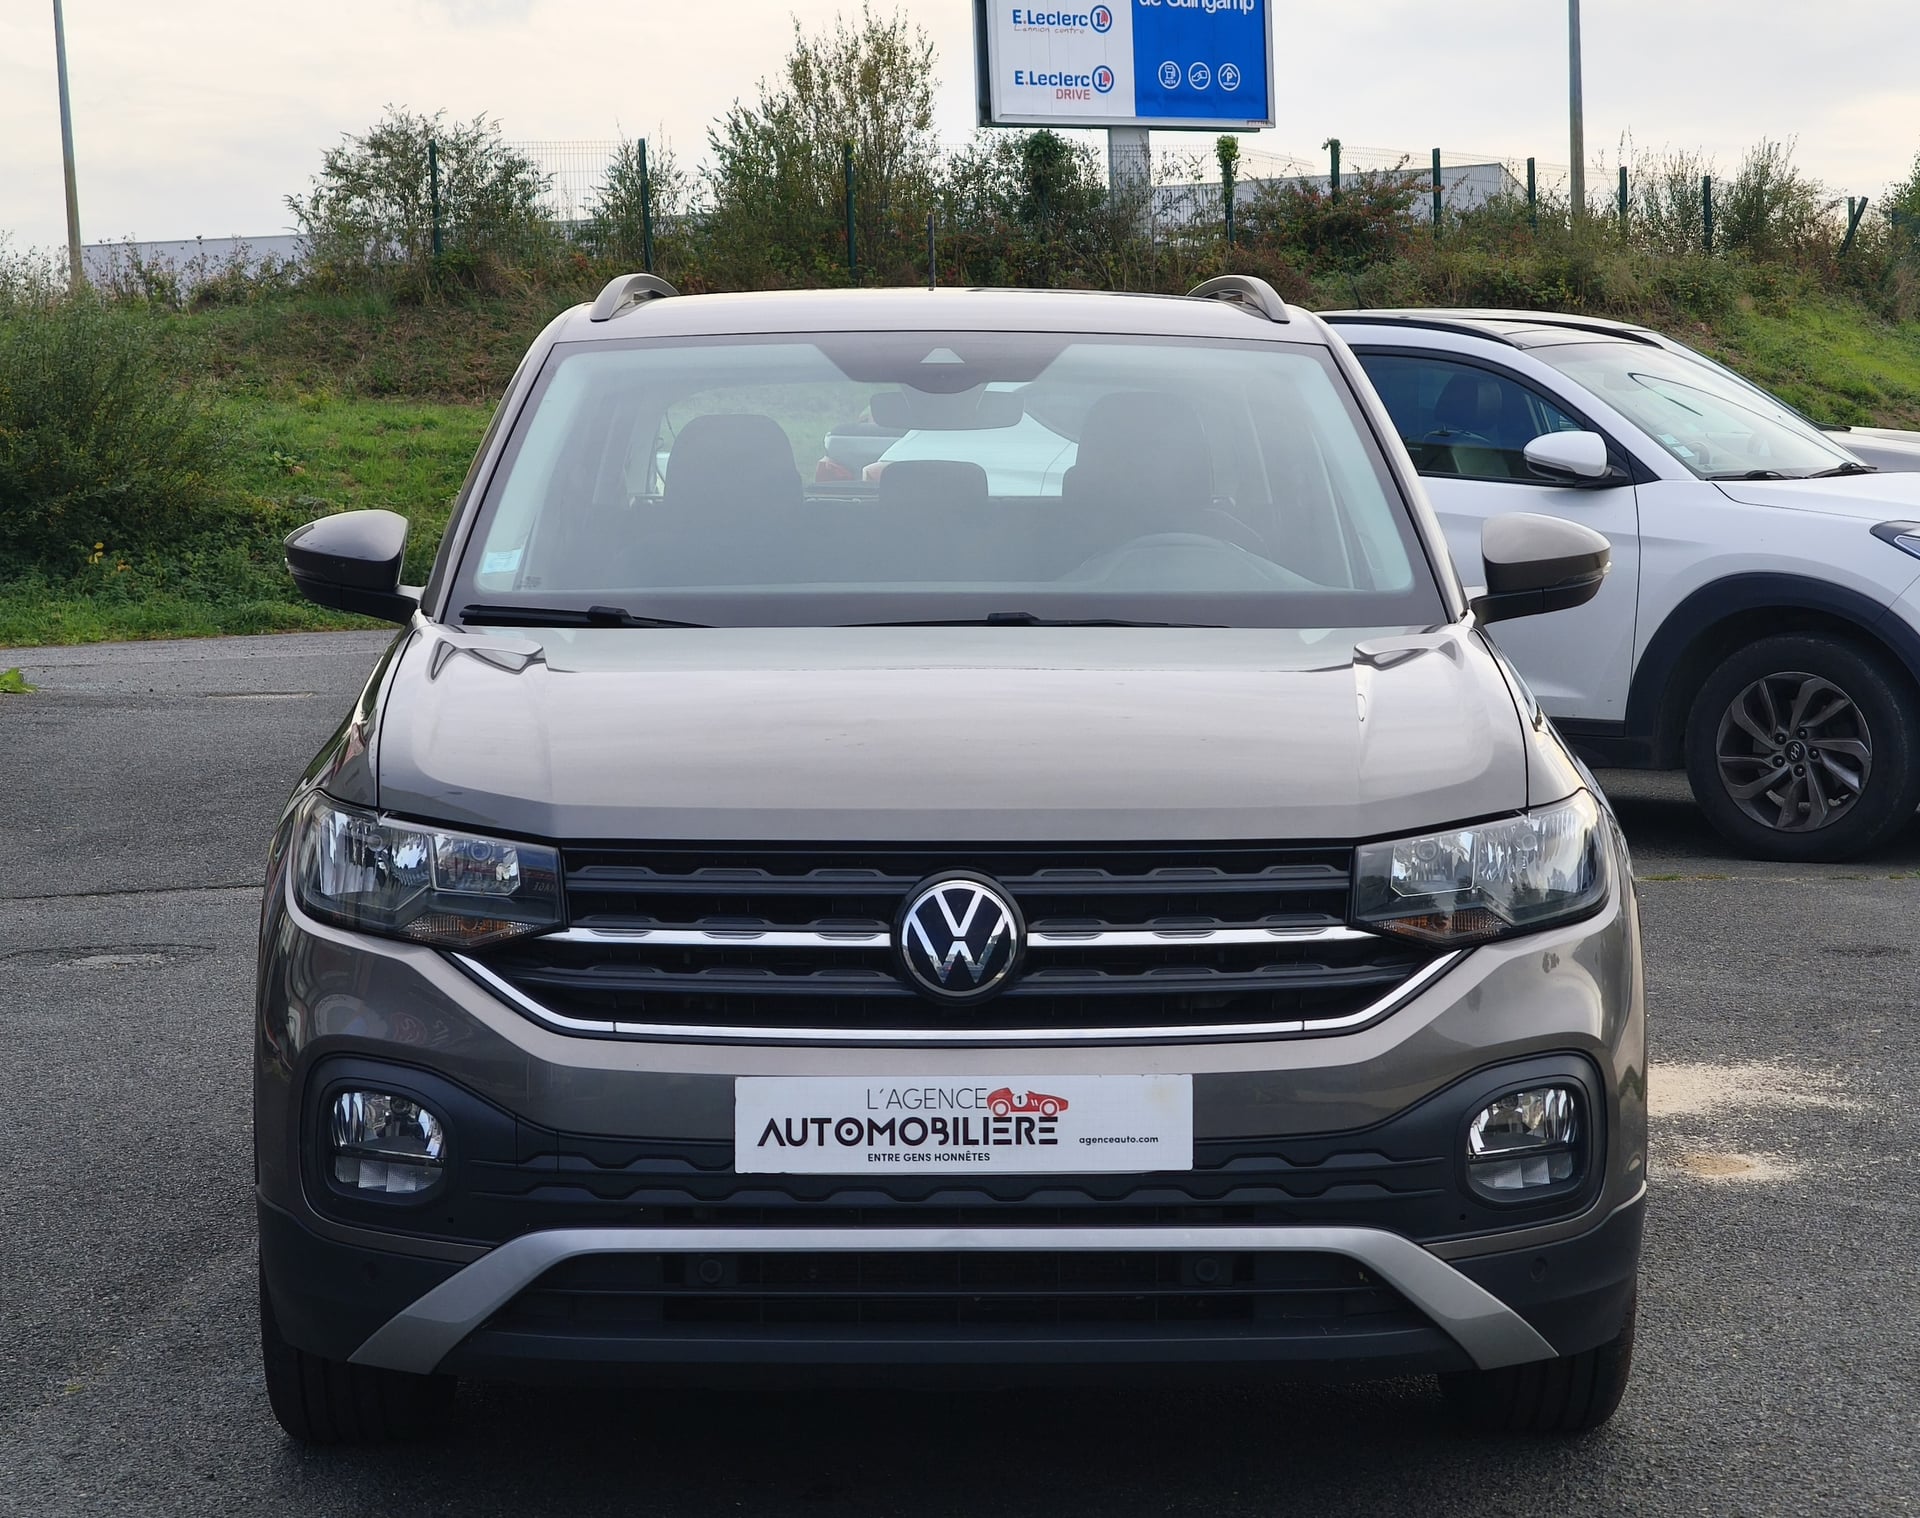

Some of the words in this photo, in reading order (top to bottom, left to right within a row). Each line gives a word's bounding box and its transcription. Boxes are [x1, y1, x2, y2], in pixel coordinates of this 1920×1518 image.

[1012, 9, 1089, 27] E.Leclerc
[1014, 70, 1090, 87] E.Leclerc
[1056, 88, 1091, 101] DRIVE
[866, 1087, 988, 1110] L'AGENCE
[1078, 1135, 1159, 1145] agenceauto.com
[867, 1152, 901, 1162] ENTRE
[903, 1152, 932, 1162] GENS
[934, 1150, 991, 1162] HONNÊTES
